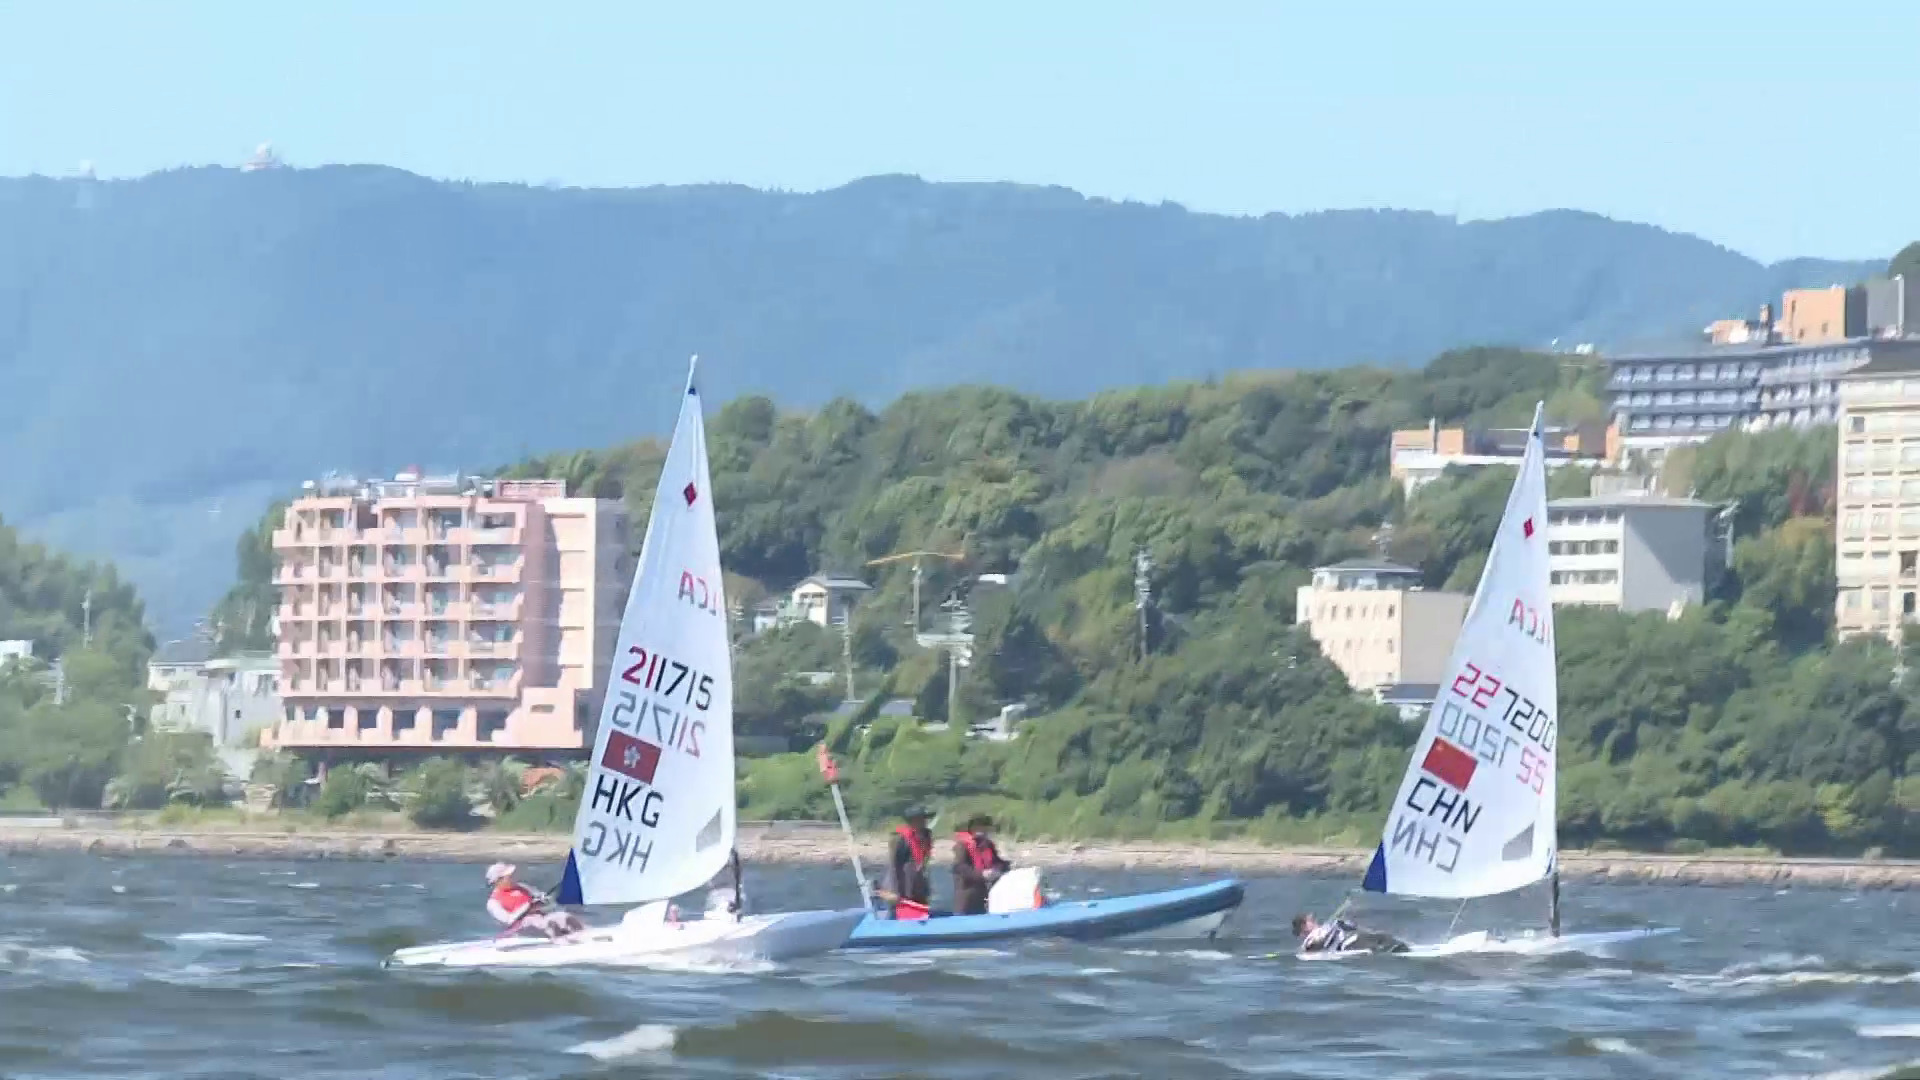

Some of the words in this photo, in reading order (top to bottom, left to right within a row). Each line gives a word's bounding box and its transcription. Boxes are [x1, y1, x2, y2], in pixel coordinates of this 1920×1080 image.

[621, 645, 715, 711] 211715
[591, 774, 664, 829] HKG
[1406, 777, 1482, 834] CHN
